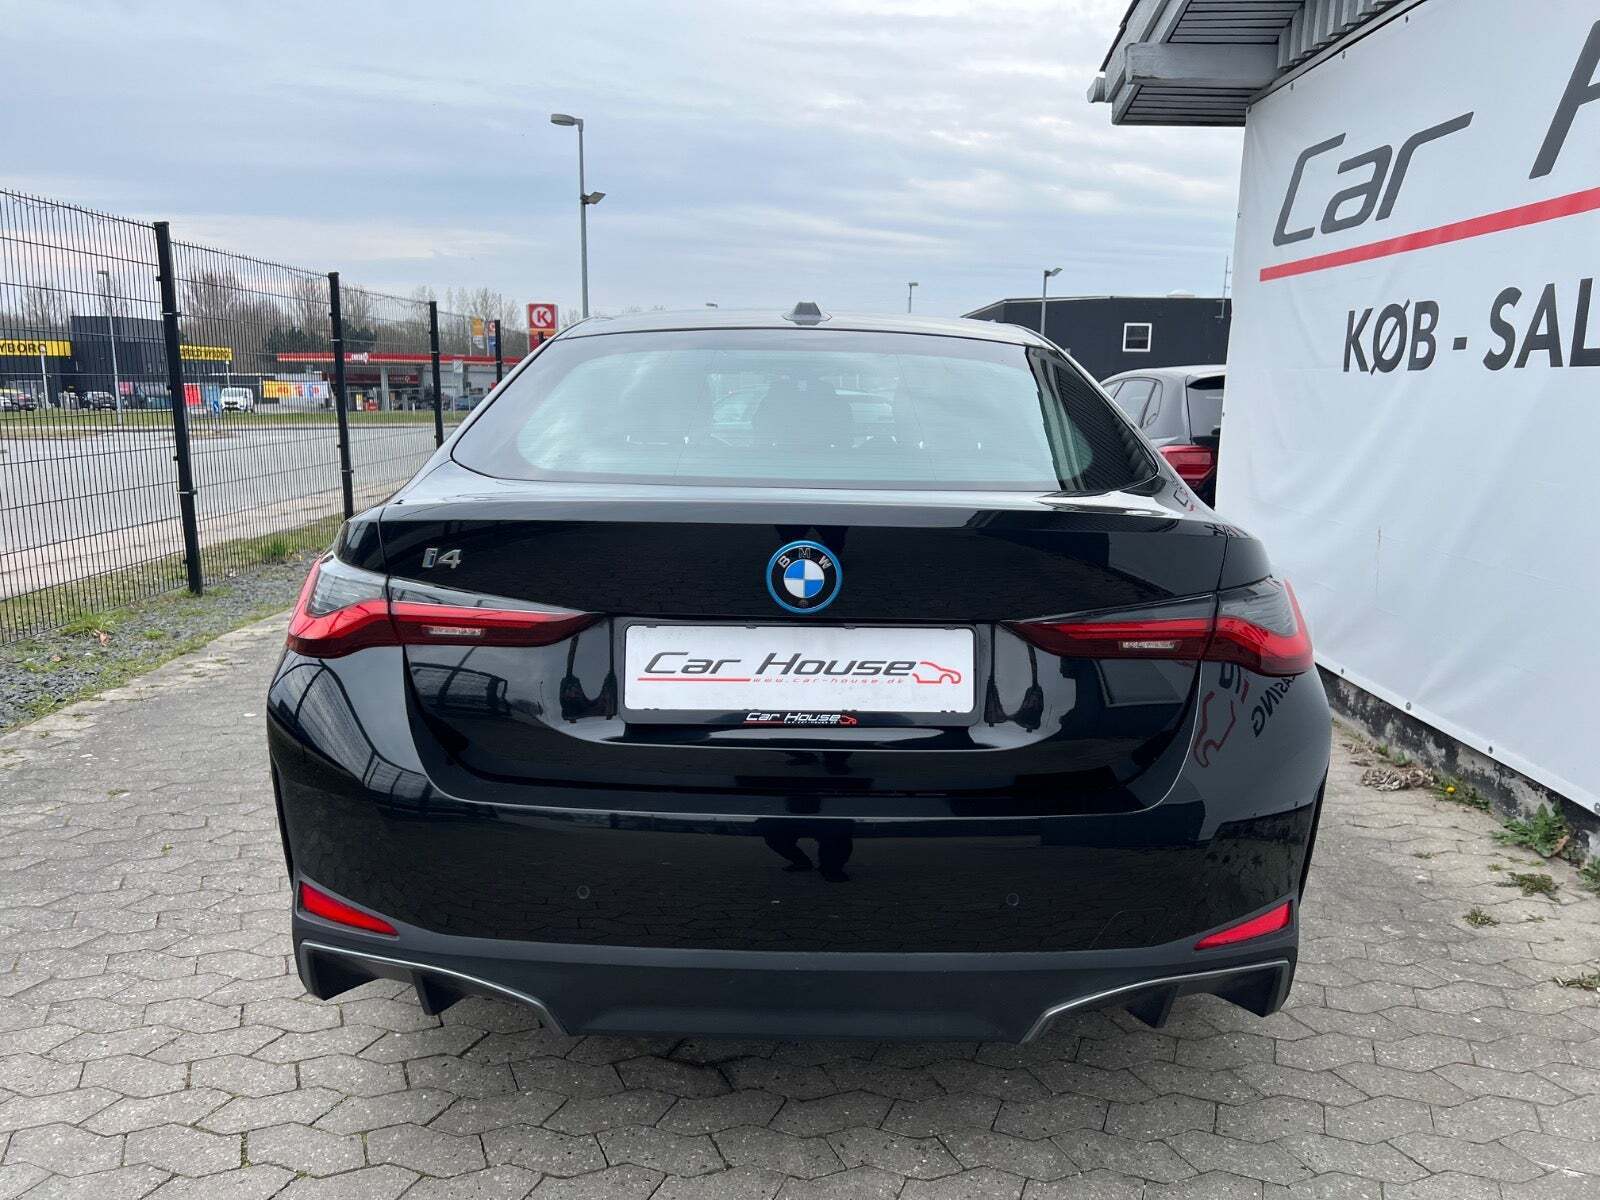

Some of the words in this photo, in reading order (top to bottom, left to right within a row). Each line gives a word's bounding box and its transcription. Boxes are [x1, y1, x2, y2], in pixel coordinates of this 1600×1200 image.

[1273, 112, 1474, 247] Car
[1343, 299, 1440, 375] KØB
[422, 547, 461, 569] i4
[777, 547, 833, 570] BMW
[644, 651, 742, 675] Car
[755, 652, 917, 676] House
[746, 712, 780, 721] Car
[784, 712, 841, 722] House
